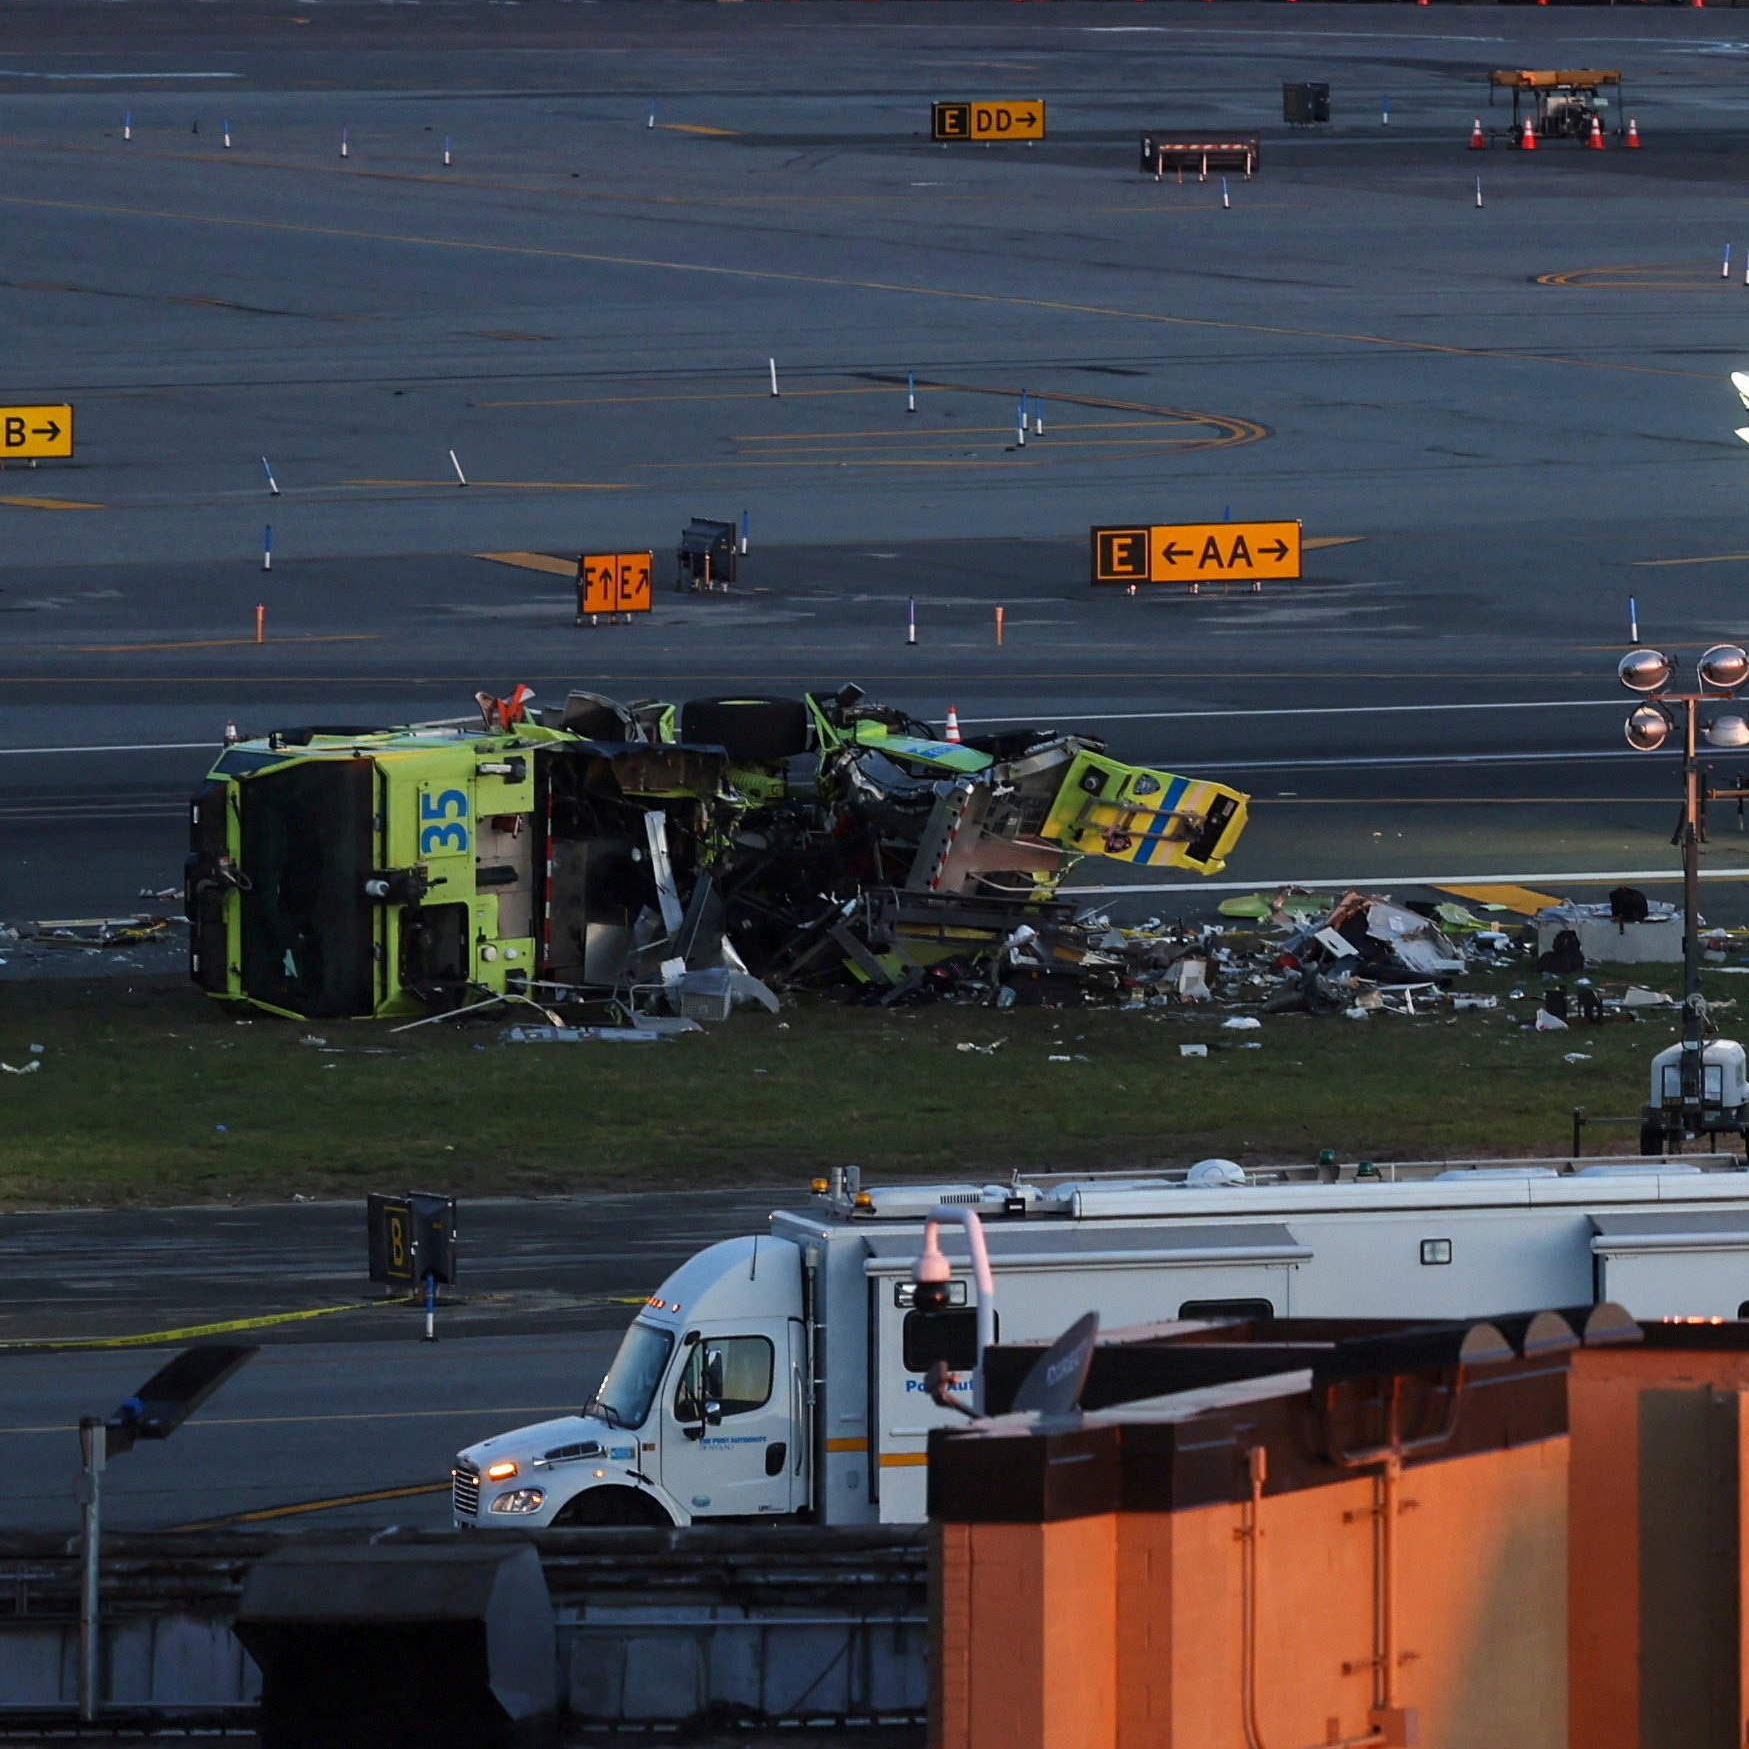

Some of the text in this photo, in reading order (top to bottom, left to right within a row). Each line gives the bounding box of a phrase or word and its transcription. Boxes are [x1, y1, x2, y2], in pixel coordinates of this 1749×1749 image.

[945, 110, 959, 133] E
[977, 109, 1012, 132] DD
[5, 417, 26, 447] B
[1111, 538, 1134, 572] E
[1198, 535, 1254, 570] AA
[584, 567, 596, 601] F
[621, 566, 632, 599] E
[420, 789, 468, 853] 35
[391, 1218, 404, 1266] B
